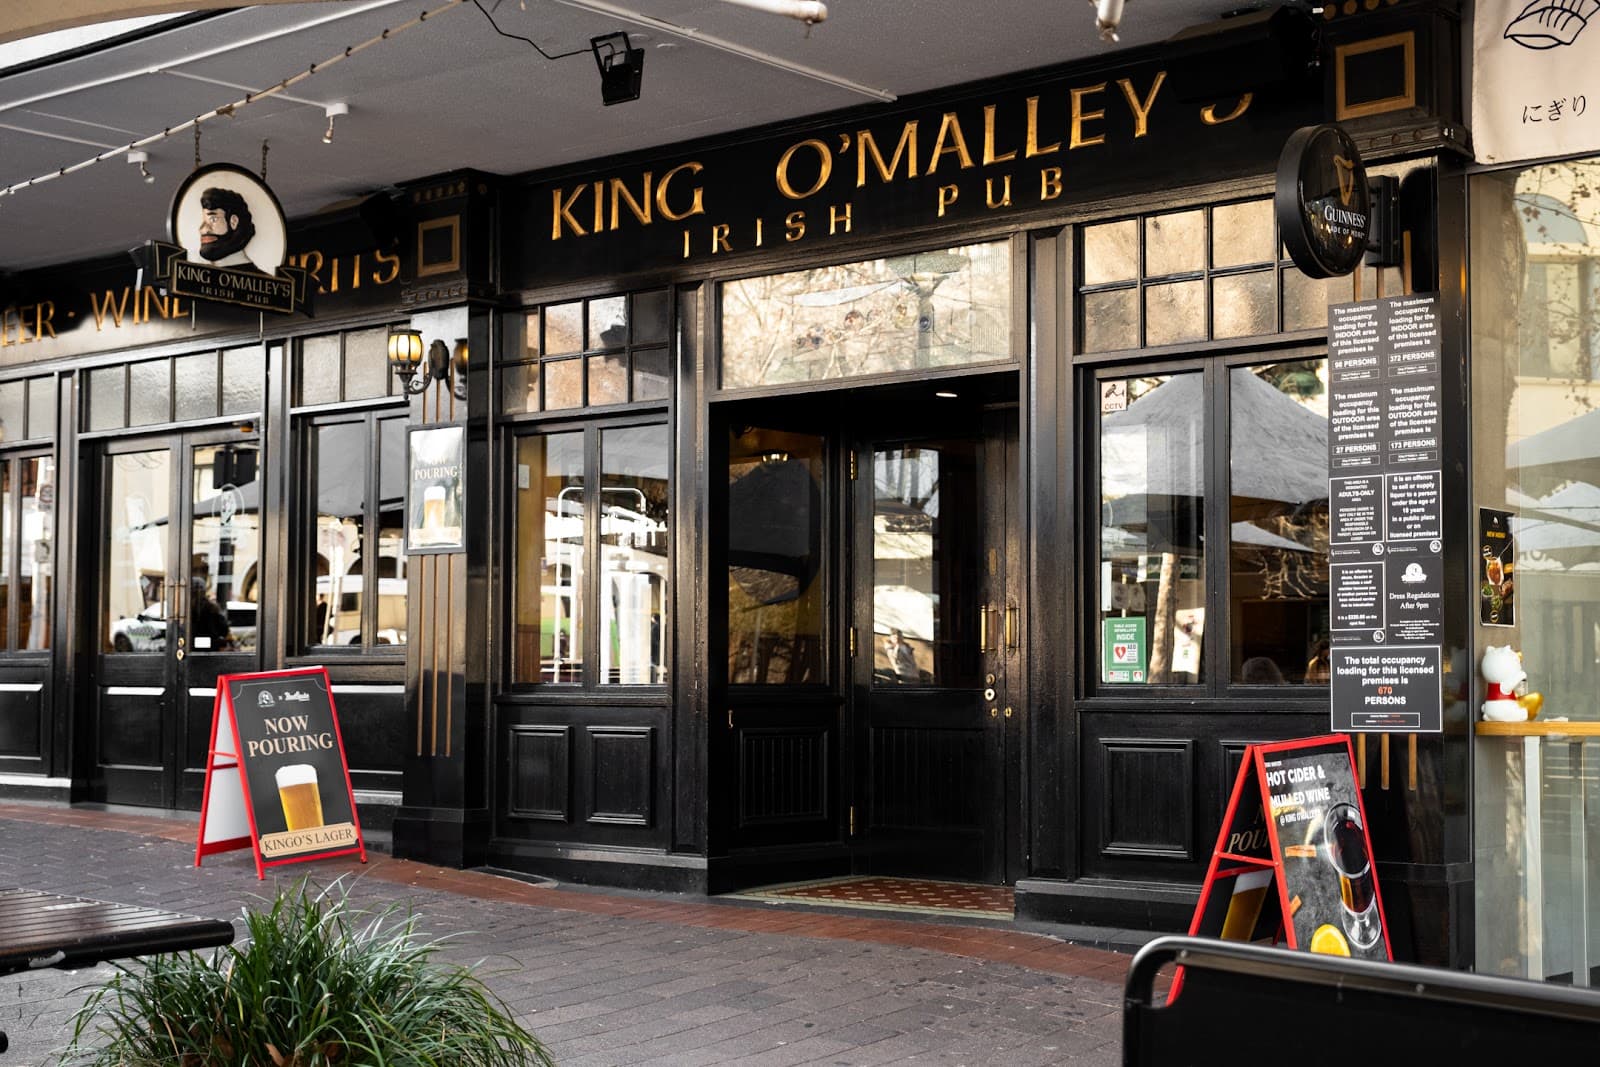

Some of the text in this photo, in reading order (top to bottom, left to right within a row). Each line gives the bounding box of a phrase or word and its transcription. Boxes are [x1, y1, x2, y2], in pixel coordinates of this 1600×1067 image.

[1523, 95, 1586, 124] にぎり
[552, 71, 1252, 241] KING O'MALLEY
[683, 166, 1064, 258] IRISH PUB
[1324, 205, 1366, 228] GUINNESS
[178, 265, 291, 297] KING O'MALLEY'S
[201, 286, 269, 304] IRISH PUB
[1403, 298, 1434, 306] maximum
[1347, 305, 1377, 313] maximum
[1394, 306, 1430, 316] occupancy
[1338, 314, 1372, 322] occupancy
[1389, 316, 1412, 324] loading
[1, 300, 57, 348] EER
[1390, 323, 1418, 332] INDOOR
[1335, 330, 1361, 338] INDOOR
[1410, 330, 1436, 338] licensed
[1353, 336, 1380, 344] licensed
[1402, 351, 1434, 360] PERSONS
[1344, 358, 1377, 366] PERSONS
[1348, 391, 1378, 399] maximum
[1395, 394, 1430, 402] occupancy
[1338, 400, 1373, 408] occupancy
[1389, 404, 1412, 412] loading
[1388, 410, 1422, 420] OUTDOOR
[1332, 416, 1366, 424] OUTDOOR
[1409, 418, 1436, 426] licensed
[1352, 422, 1380, 430] licensed
[1345, 444, 1376, 452] PERSONS
[1404, 439, 1436, 448] PERSONS
[415, 466, 458, 480] POURING
[1390, 592, 1440, 600] Dress Regulations
[1400, 602, 1429, 610] After 9pm
[1344, 656, 1426, 666] The total occupancy
[1336, 666, 1434, 676] loading for this licensed
[1362, 676, 1408, 686] premises is
[1378, 686, 1392, 695] 670
[1364, 696, 1406, 705] PERSONS
[264, 715, 309, 735] NOW
[248, 733, 334, 758] POURING
[1266, 764, 1326, 787] HOT CIDER &
[1270, 787, 1331, 807] MULLED WINE
[264, 829, 354, 852] KINGO'S LAGER
